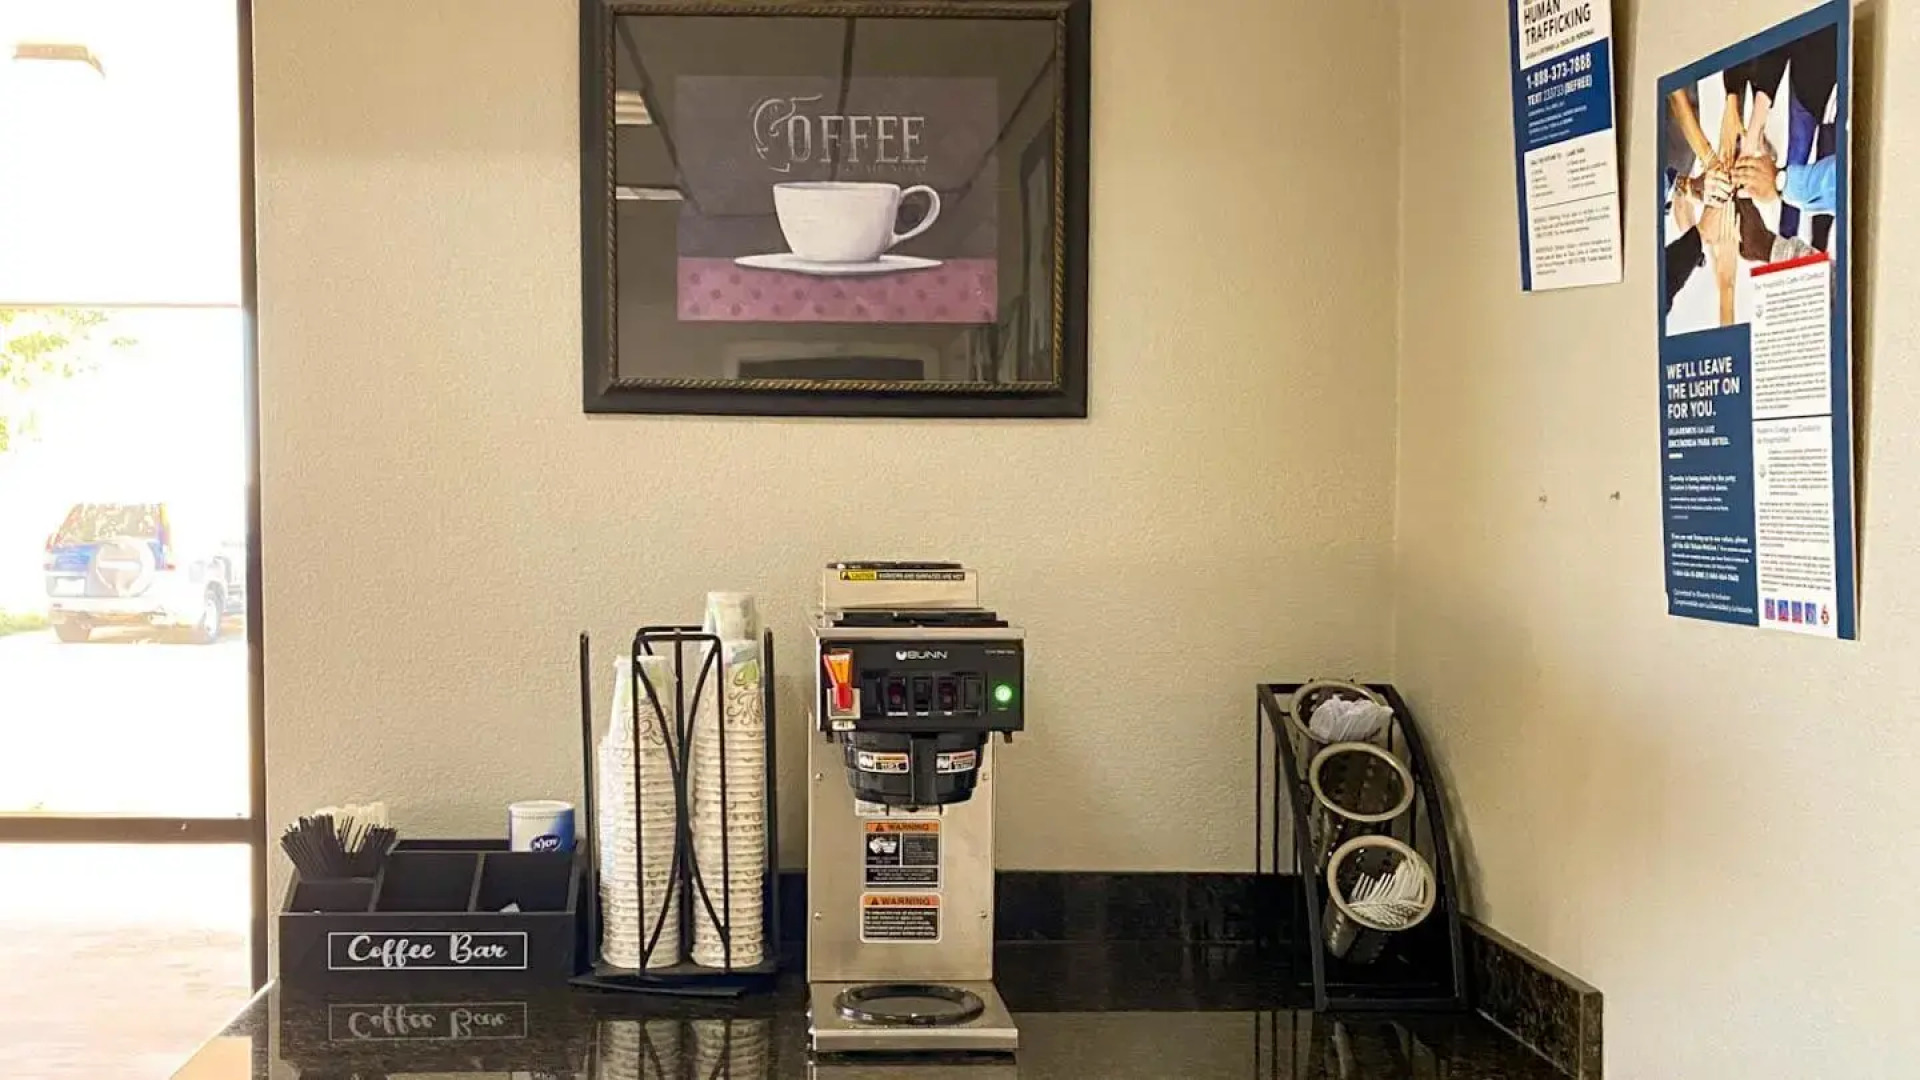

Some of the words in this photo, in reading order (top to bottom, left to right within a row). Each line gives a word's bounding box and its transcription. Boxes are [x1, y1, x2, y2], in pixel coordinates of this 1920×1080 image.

[1524, 0, 1560, 25] HUMAN
[1525, 3, 1591, 47] TRAFFICKING
[1527, 52, 1591, 89] 1-888-373-7888
[1527, 92, 1542, 106] TEXT
[752, 93, 928, 173] COFFEE
[1667, 362, 1696, 379] WE'LL
[1699, 356, 1732, 376] LEAVE
[1667, 383, 1686, 400] THE
[1689, 379, 1719, 398] LIGHT
[1723, 376, 1740, 395] ON
[1668, 402, 1688, 419] FOR
[1691, 400, 1716, 417] YOU.
[907, 650, 948, 659] BUNN
[888, 823, 929, 832] WARNING
[882, 896, 929, 905] WARNING
[348, 934, 436, 968] Coffee
[450, 933, 508, 964] Bar
